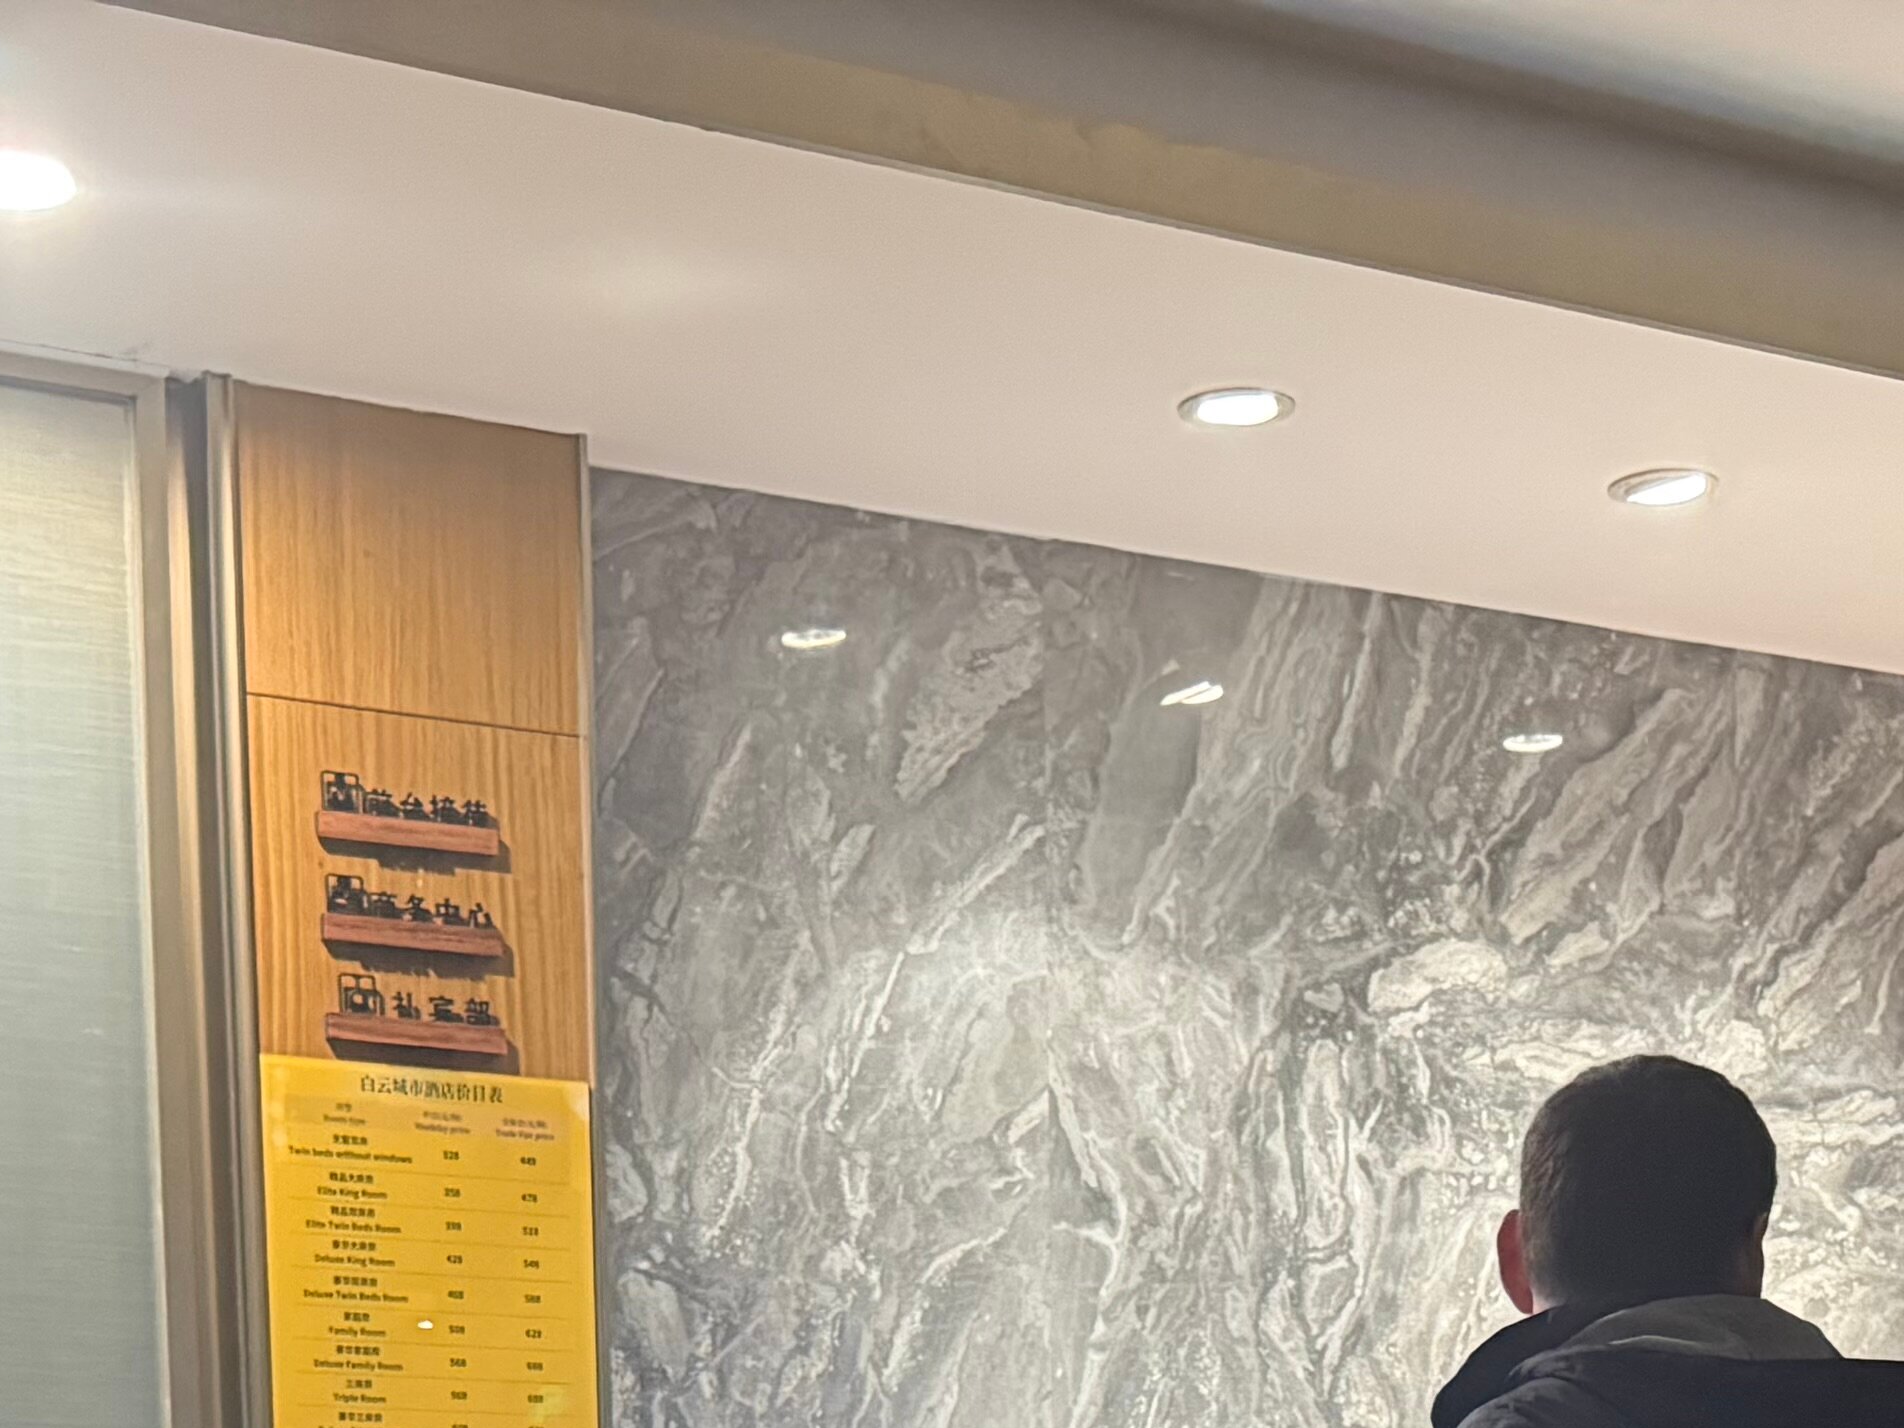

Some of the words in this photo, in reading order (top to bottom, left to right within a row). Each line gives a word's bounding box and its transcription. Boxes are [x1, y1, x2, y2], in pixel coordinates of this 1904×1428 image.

[393, 991, 491, 1025] 礼宾部
[360, 1074, 503, 1103] 白云城市酒店价目表
